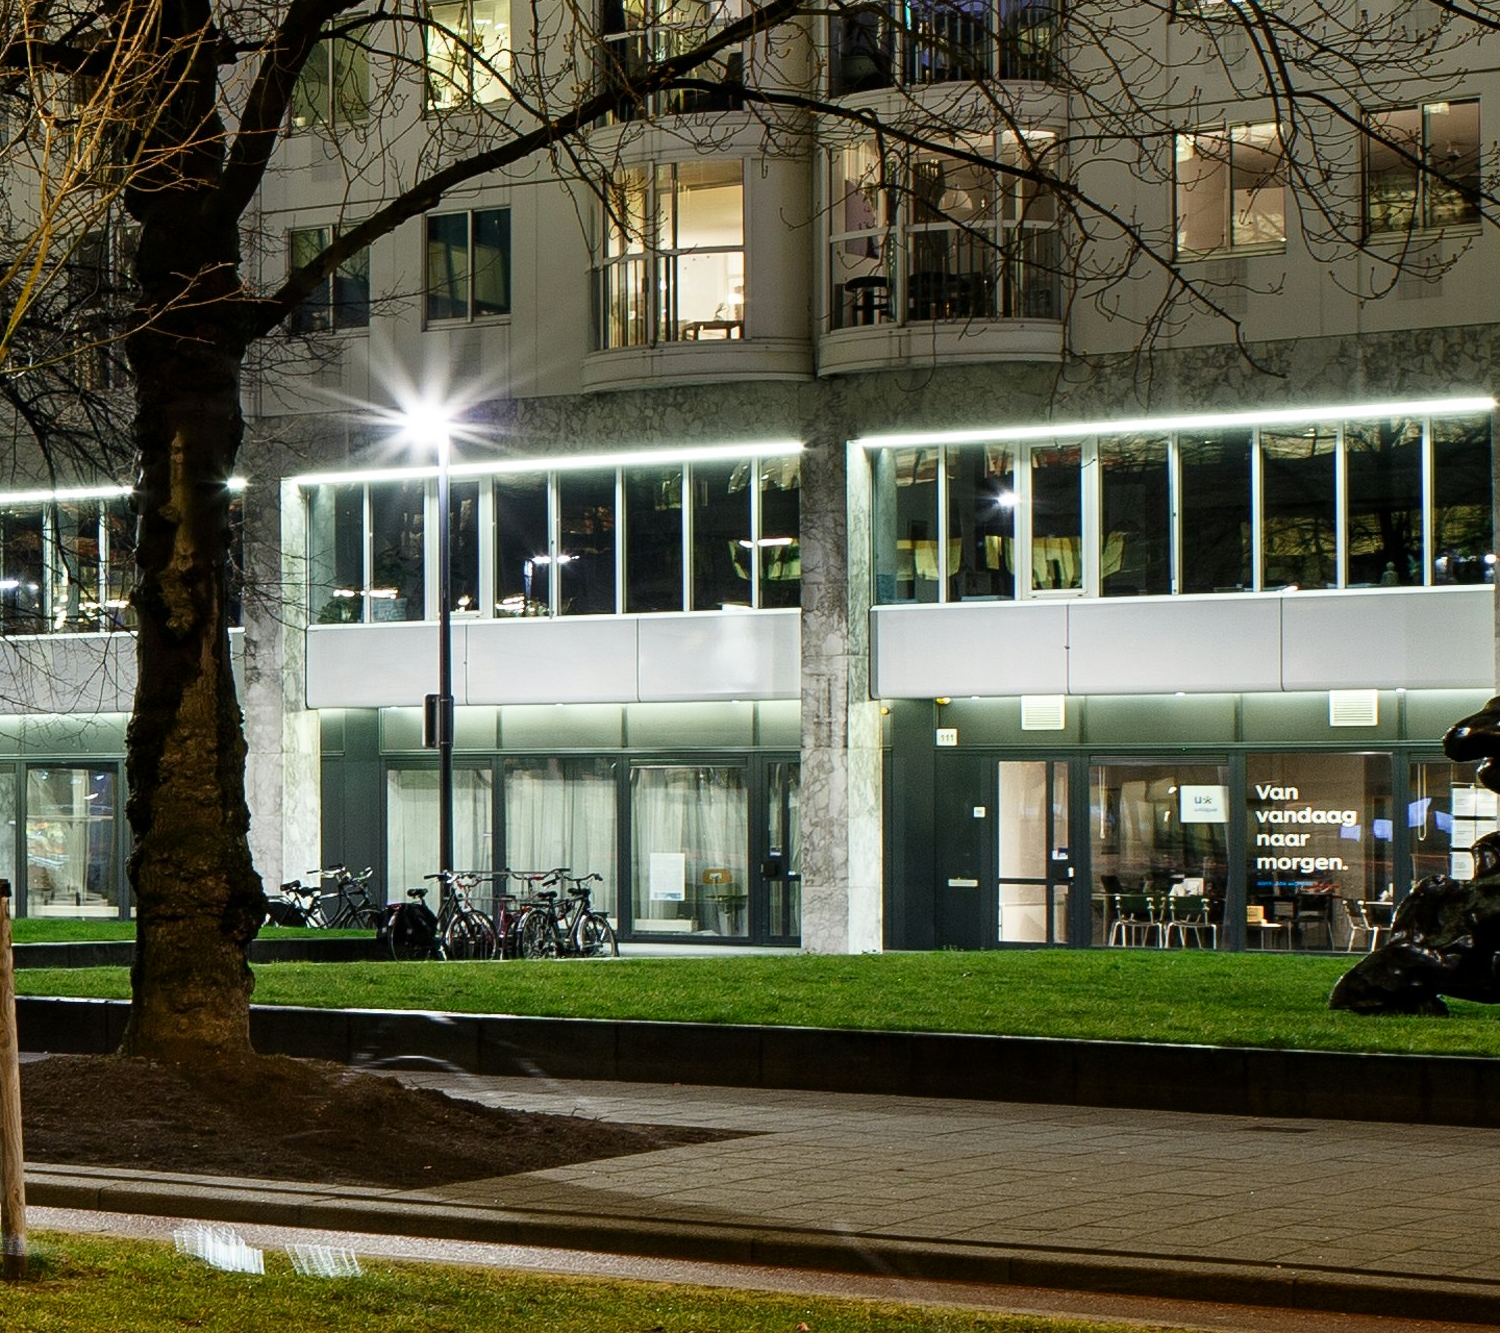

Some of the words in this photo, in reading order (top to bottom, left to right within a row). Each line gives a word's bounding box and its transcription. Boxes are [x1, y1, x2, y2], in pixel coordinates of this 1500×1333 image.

[1255, 785, 1299, 801] Van
[1255, 806, 1358, 828] vandaag
[1256, 833, 1311, 847] naar
[1256, 856, 1349, 874] morgen.
